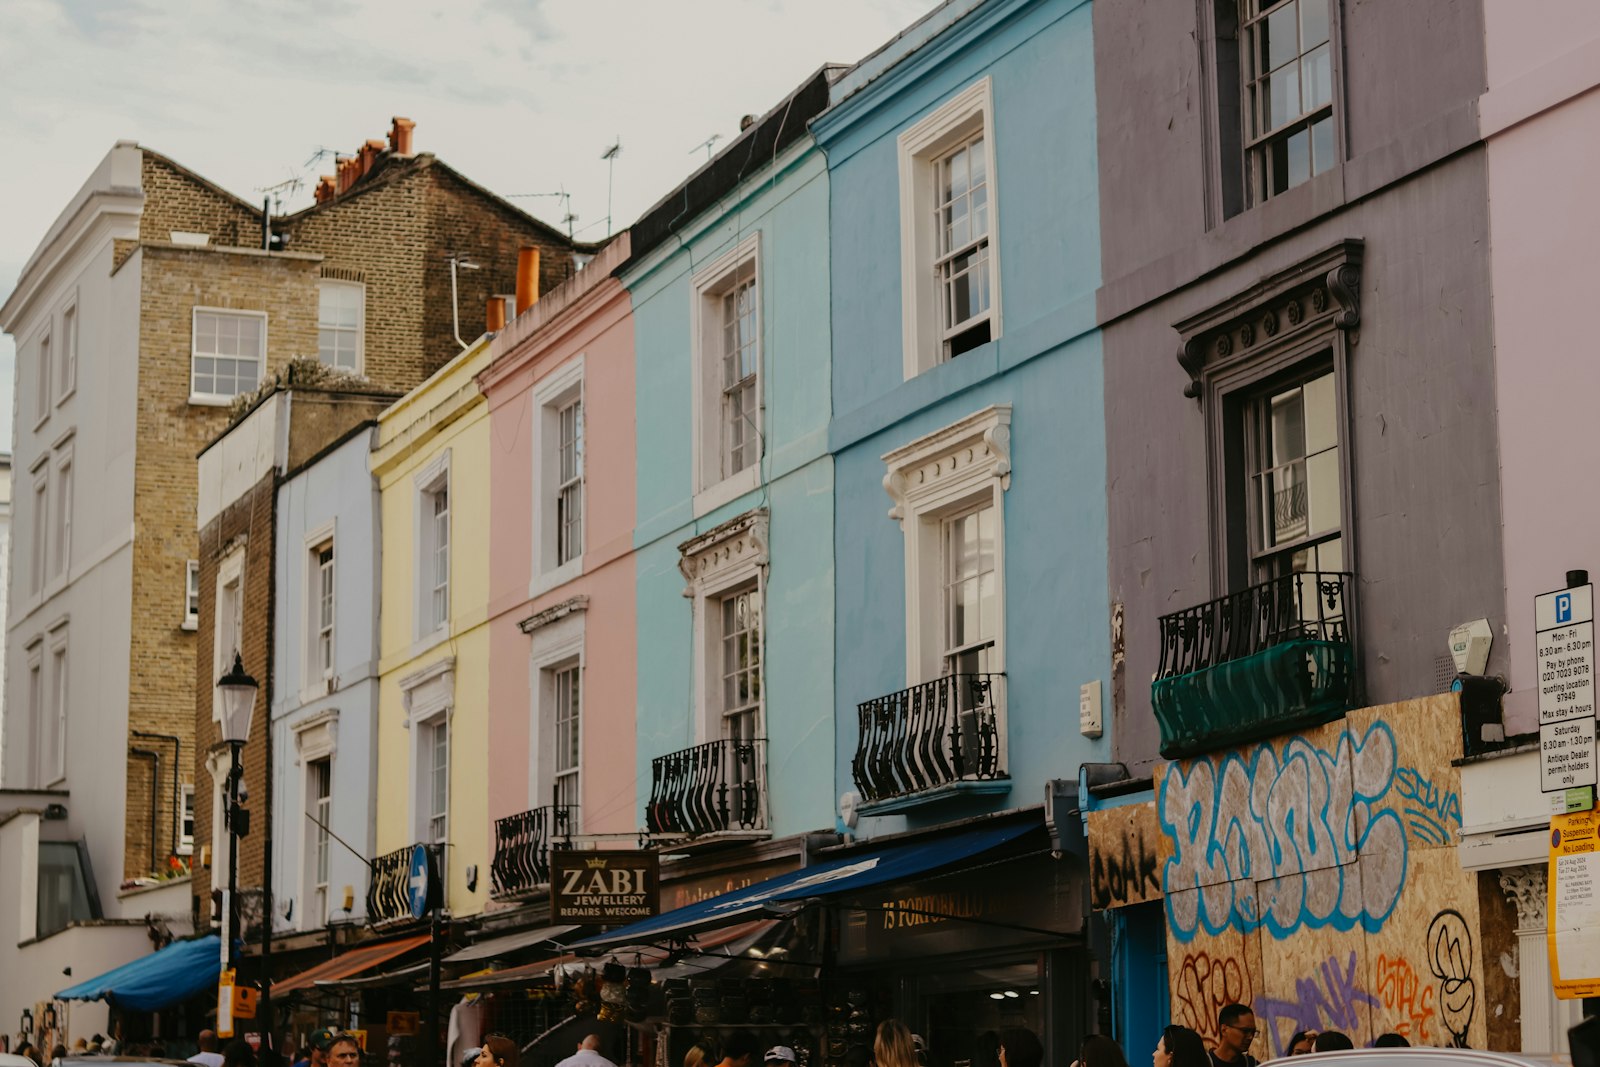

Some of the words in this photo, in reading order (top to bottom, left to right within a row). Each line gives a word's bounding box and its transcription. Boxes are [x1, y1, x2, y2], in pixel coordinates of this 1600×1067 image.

[1559, 597, 1569, 620] P
[1552, 632, 1564, 642] Mon
[1569, 629, 1577, 638] Fri
[1540, 647, 1553, 657] 8.30
[1567, 641, 1580, 652] 6.30
[1546, 661, 1556, 670] Pay
[1559, 659, 1565, 668] by
[1567, 656, 1585, 667] phone
[1543, 672, 1554, 681] 020
[1556, 669, 1572, 679] 7023
[1574, 665, 1589, 675] 9078
[1543, 684, 1564, 695] quoting
[1566, 679, 1589, 689] location
[1557, 691, 1576, 702] 97949
[1542, 711, 1554, 719] Max
[1556, 708, 1568, 717] stay
[1575, 704, 1592, 713] hours
[1555, 725, 1580, 735] Saturday
[1544, 740, 1557, 750] 8.30
[1570, 736, 1582, 746] 1.30
[1548, 754, 1569, 763] Antique
[1571, 750, 1589, 760] Dealer
[1548, 766, 1566, 776] permit
[1568, 761, 1589, 771] holders
[1562, 775, 1574, 784] only
[1568, 817, 1589, 826] Parking
[1563, 827, 1595, 838] Suspension
[1572, 843, 1594, 852] Loading
[561, 869, 648, 895] ZABI
[573, 895, 646, 906] JEWELLERY
[560, 907, 600, 916] REPAIRS
